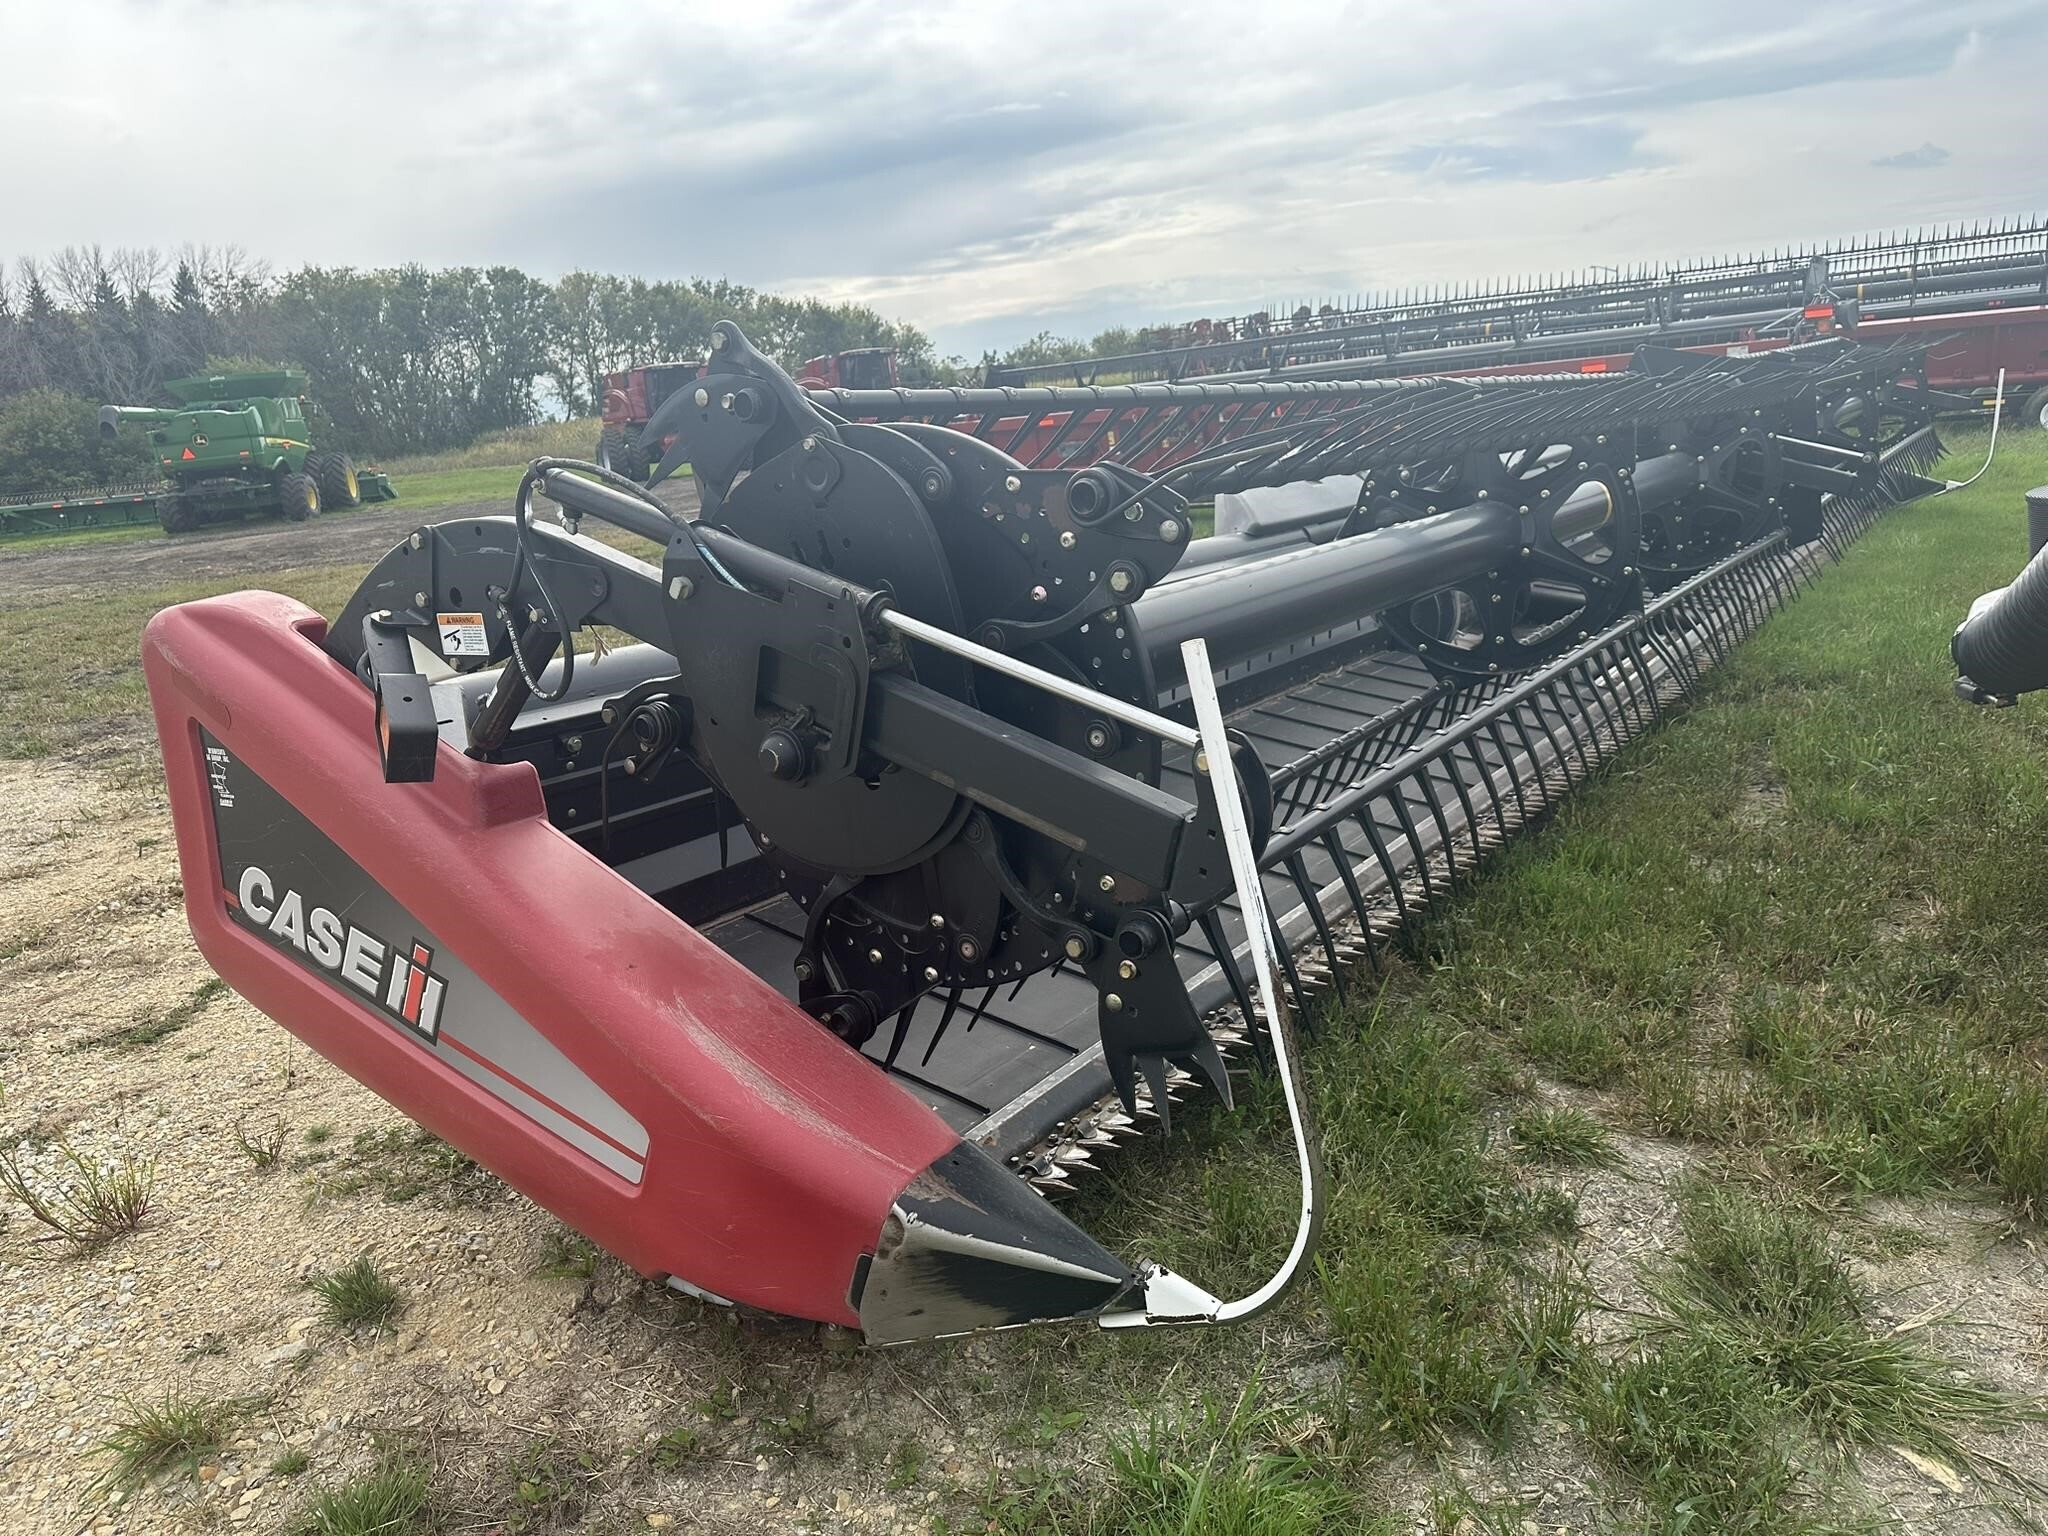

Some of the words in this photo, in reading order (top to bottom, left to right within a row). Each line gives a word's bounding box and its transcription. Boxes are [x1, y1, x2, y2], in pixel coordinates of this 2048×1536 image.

[451, 616, 475, 624] WARNING
[512, 640, 527, 673] RESISTANT
[239, 866, 385, 997] CASE
